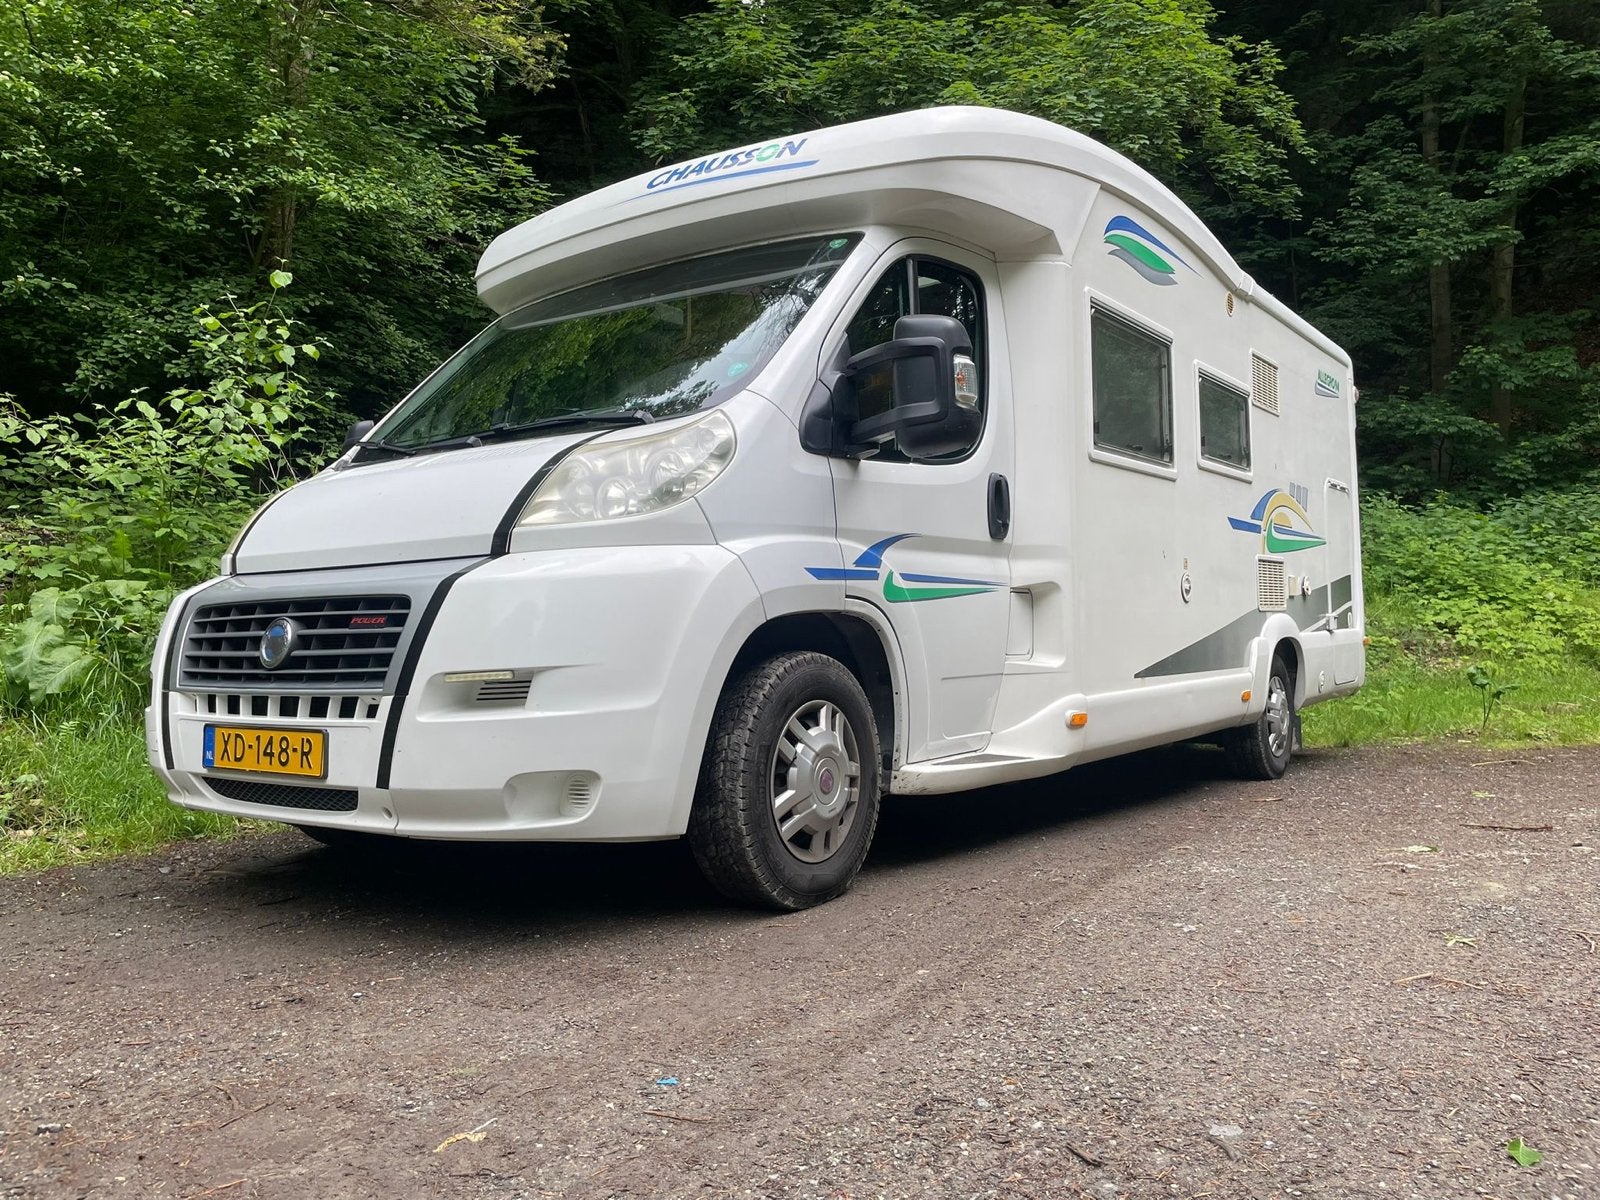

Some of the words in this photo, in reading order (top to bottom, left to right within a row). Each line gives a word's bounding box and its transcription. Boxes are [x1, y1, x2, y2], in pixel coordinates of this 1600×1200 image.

[646, 138, 808, 189] CHAUSSON
[350, 617, 386, 625] POWER
[206, 750, 214, 760] NL
[220, 731, 313, 769] XD-148-R
